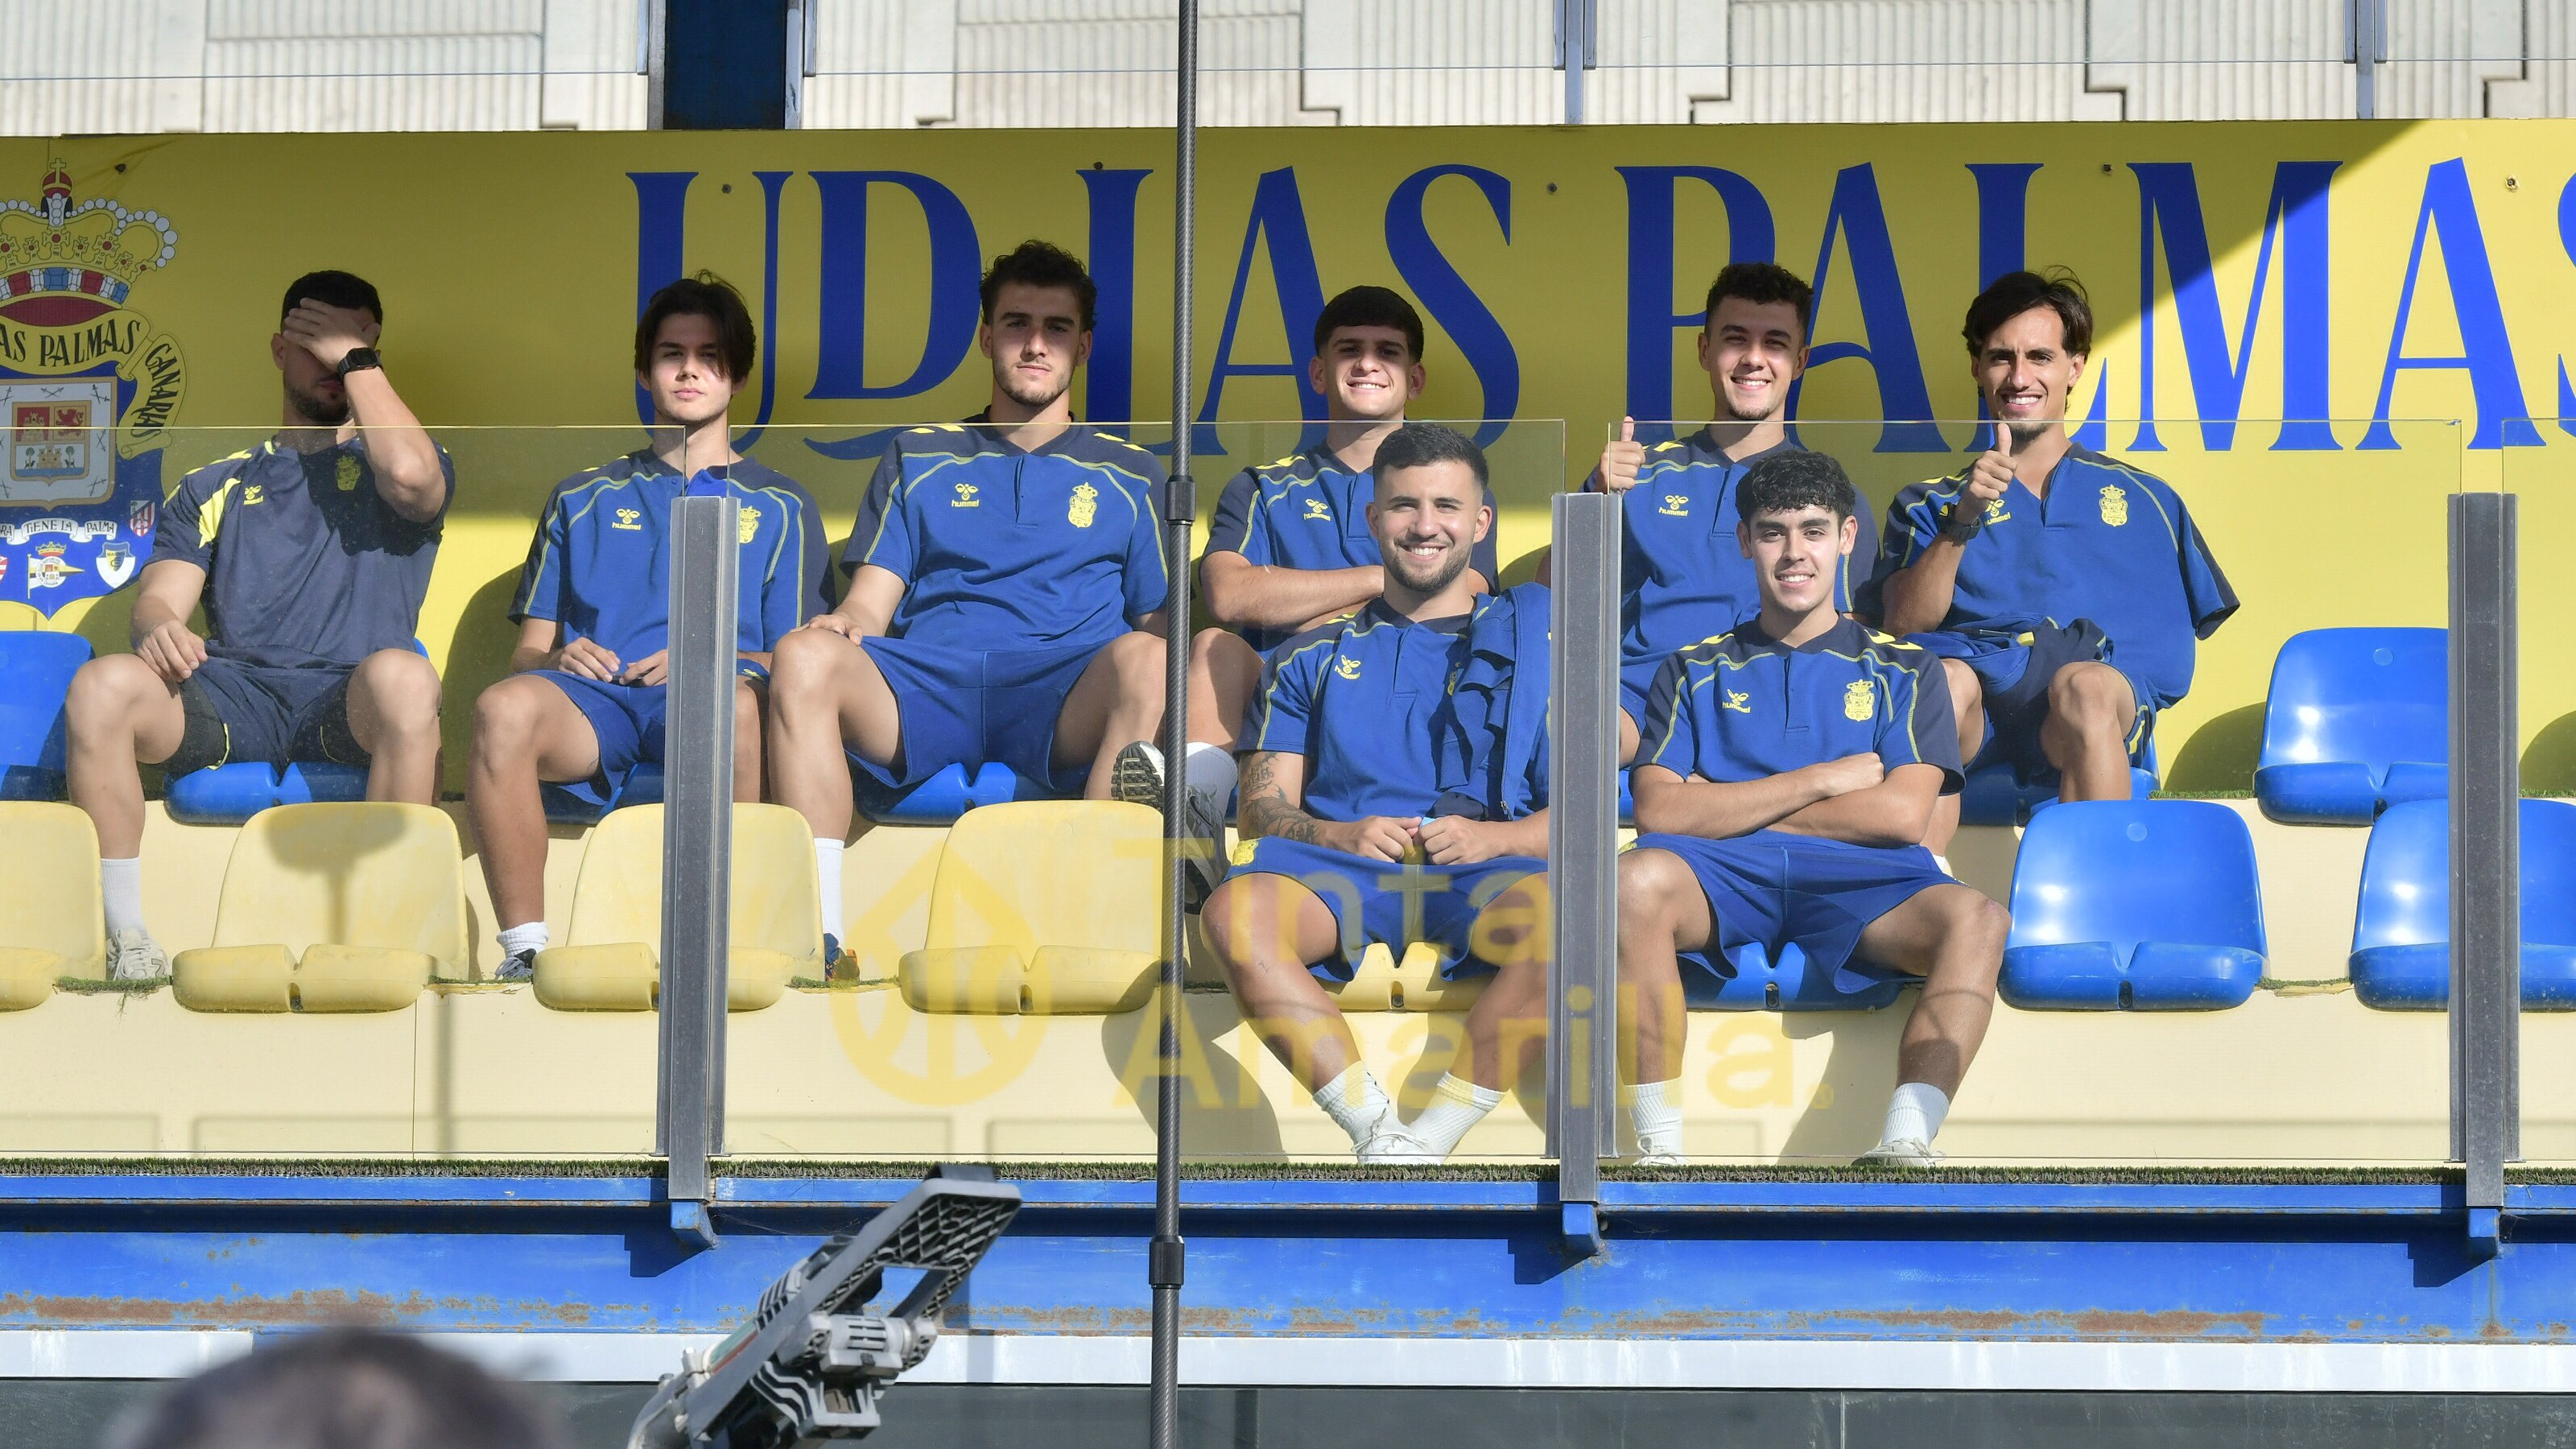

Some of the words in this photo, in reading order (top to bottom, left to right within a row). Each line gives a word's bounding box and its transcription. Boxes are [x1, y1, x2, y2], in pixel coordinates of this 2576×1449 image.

[625, 169, 981, 460] UD
[1075, 163, 1520, 460] LAS
[1613, 156, 2576, 453] PALMA
[39, 319, 141, 367] PALMAS
[130, 343, 180, 438] CANARIAS
[952, 499, 980, 508] hummel
[1303, 513, 1331, 522] hummel
[1658, 506, 1688, 516] hummel
[61, 520, 72, 532] LA
[86, 521, 114, 534] PALMA
[612, 522, 642, 531] hummel
[1334, 665, 1360, 679] hummel
[1722, 701, 1751, 714] hummel
